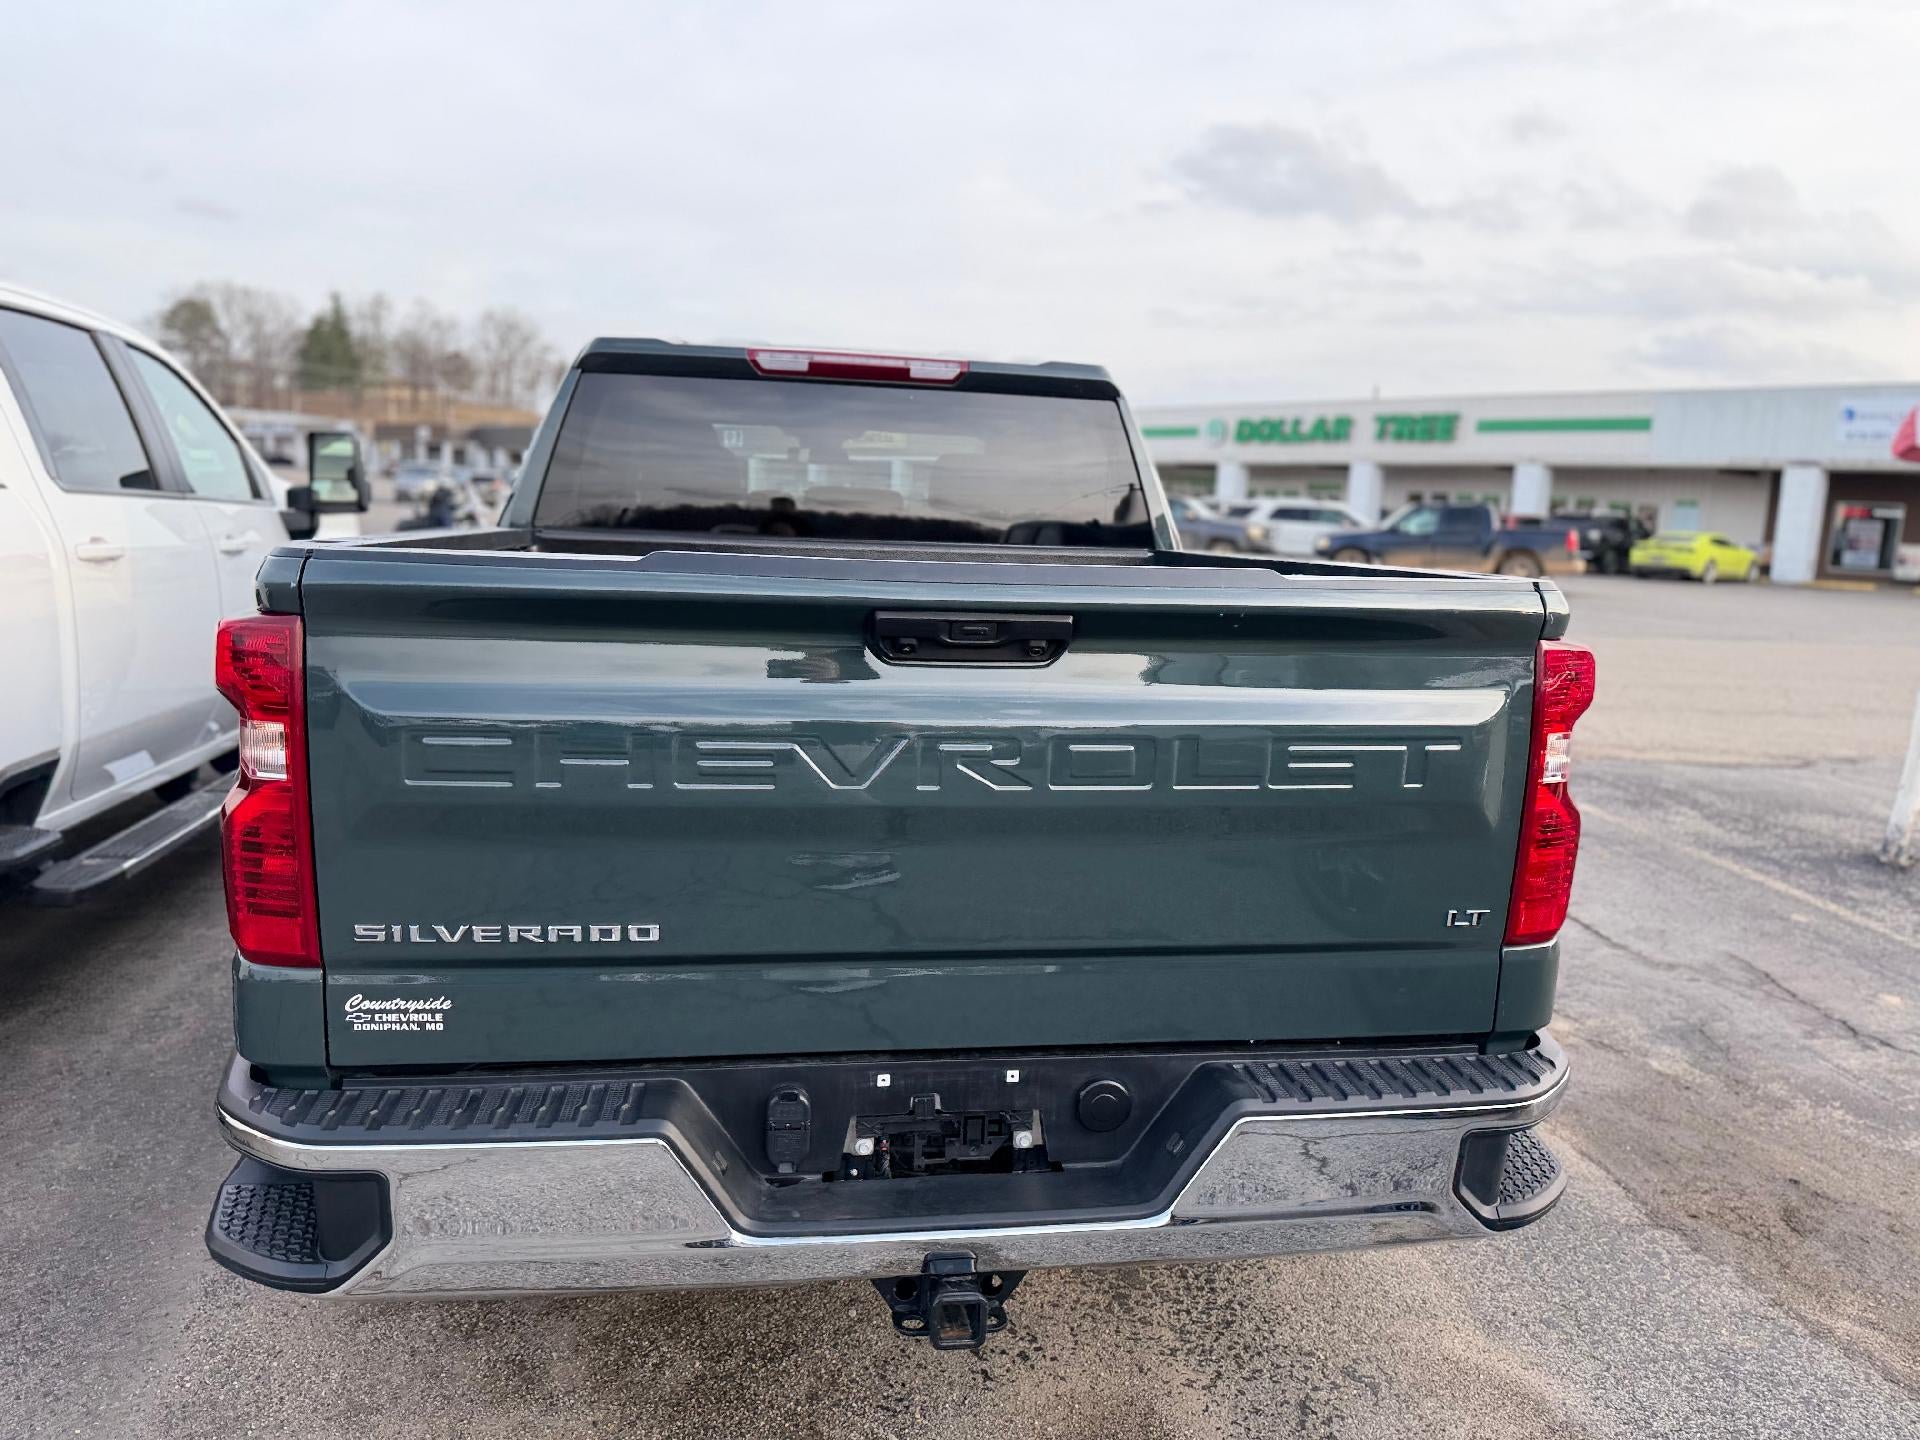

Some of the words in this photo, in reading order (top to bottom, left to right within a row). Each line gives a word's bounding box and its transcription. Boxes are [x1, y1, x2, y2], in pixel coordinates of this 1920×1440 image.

[1234, 416, 1354, 443] DOLLAR
[1373, 412, 1460, 442] TREE
[402, 728, 1463, 793] CHEVROLET
[1446, 909, 1491, 927] LT
[353, 923, 661, 943] SILVERADO
[344, 994, 453, 1013] Countryside
[425, 1023, 444, 1031] MO
